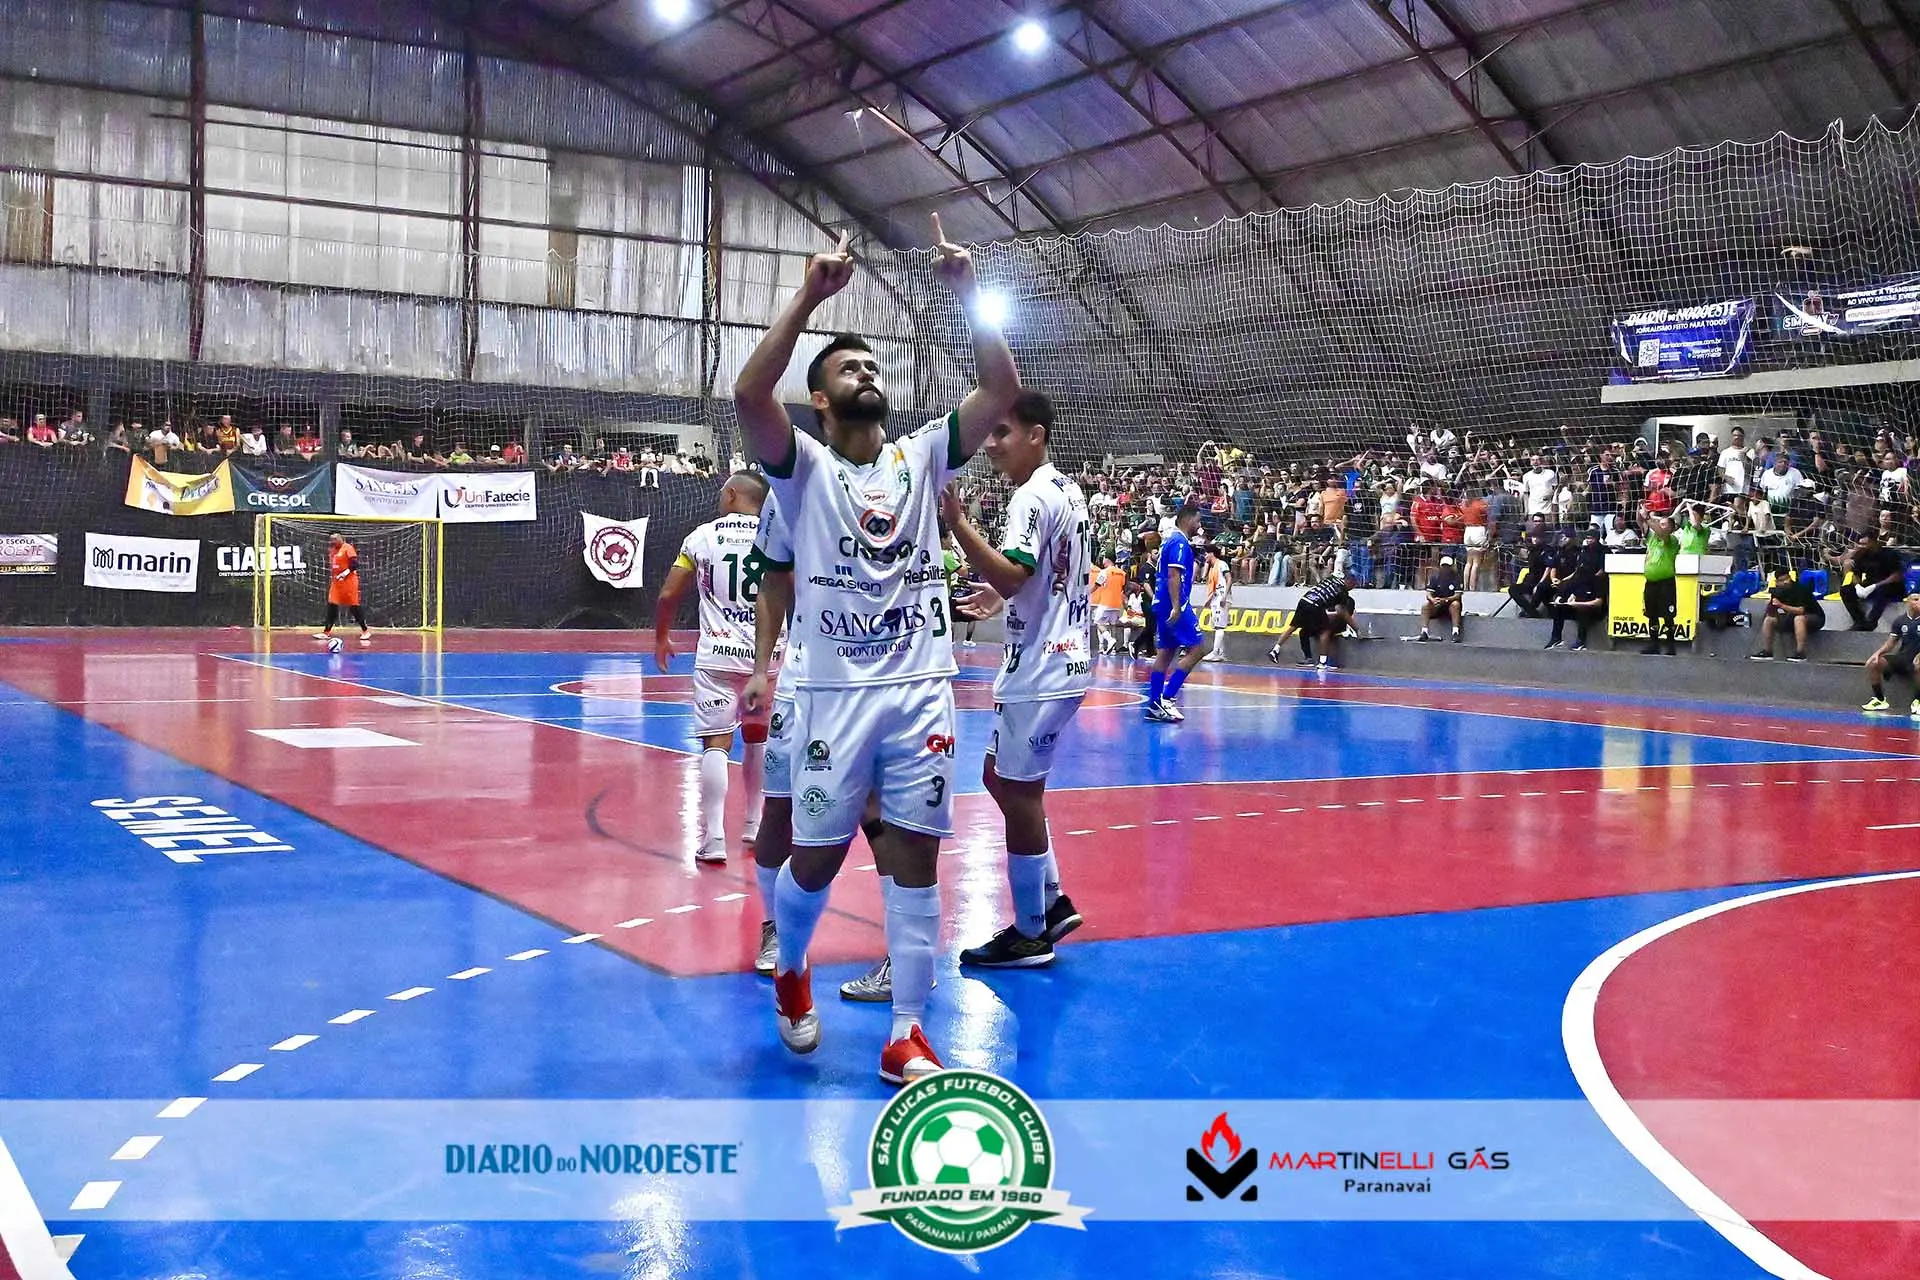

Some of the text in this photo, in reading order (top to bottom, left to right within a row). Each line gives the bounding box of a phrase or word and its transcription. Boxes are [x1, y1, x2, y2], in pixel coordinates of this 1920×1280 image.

[247, 492, 311, 507] CRESOL
[465, 489, 530, 503] UniFatecie
[117, 551, 191, 573] marin
[90, 796, 296, 863] SEMEL
